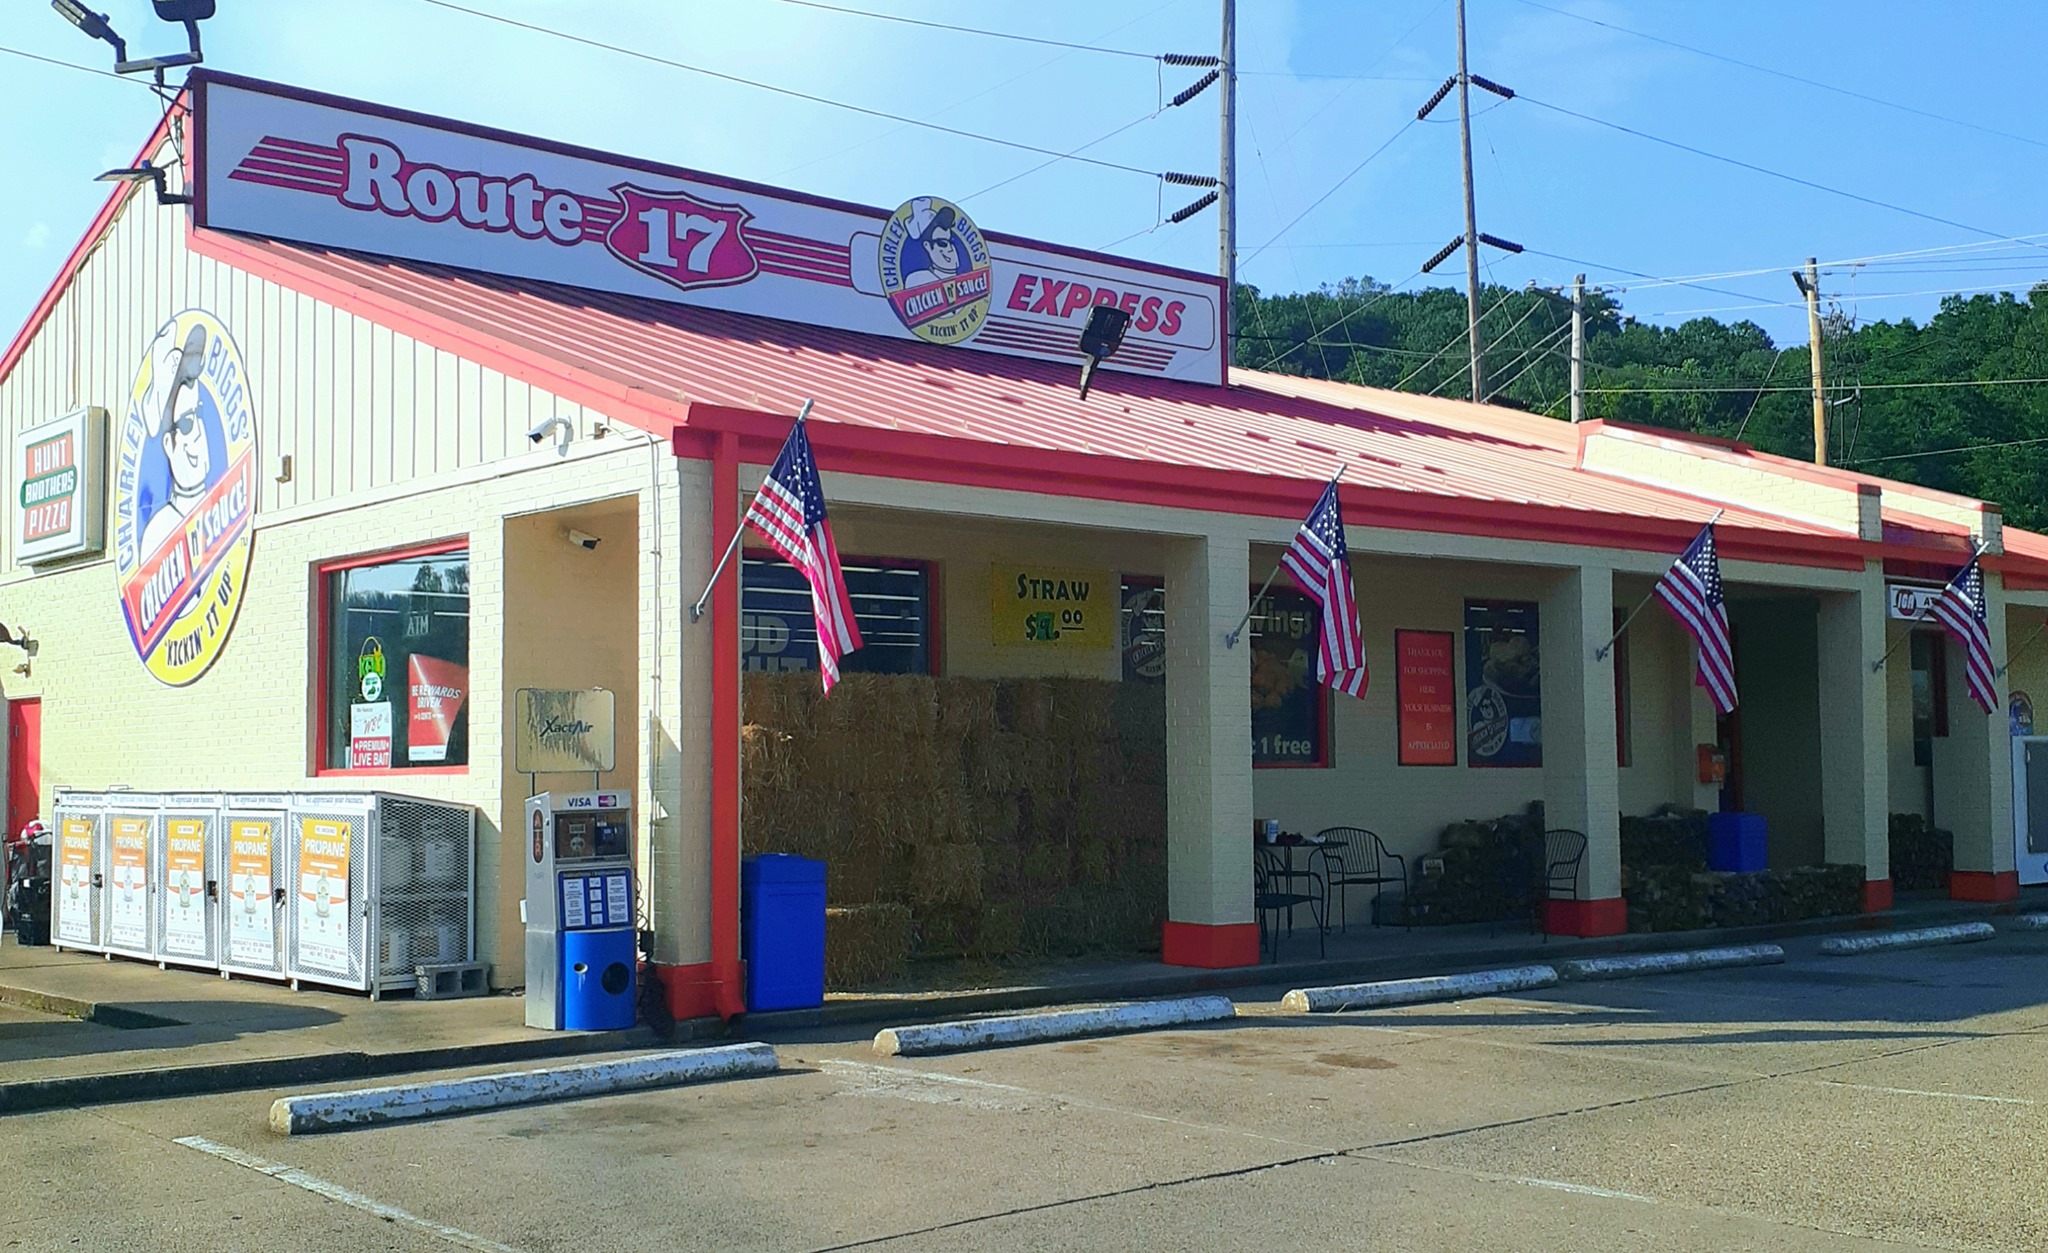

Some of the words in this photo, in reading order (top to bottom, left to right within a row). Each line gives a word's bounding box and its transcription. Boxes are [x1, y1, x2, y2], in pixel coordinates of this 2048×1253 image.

[339, 134, 585, 244] Route
[637, 205, 728, 274] 17
[882, 217, 905, 288] CHARLEY
[905, 287, 944, 317] CHICKEN
[1006, 273, 1186, 336] EXPRESS
[959, 317, 969, 331] IT
[34, 439, 67, 474] HUNT
[25, 470, 74, 504] BROTHERS
[118, 400, 144, 575] CHARLEY
[29, 500, 68, 536] PIZZA
[140, 540, 187, 633] CHICKEN
[1017, 573, 1090, 601] STRAW
[205, 601, 219, 638] IT
[406, 613, 429, 637] ATM
[411, 684, 418, 697] BE
[419, 684, 461, 699] REWARDS
[1405, 703, 1423, 712] YOUR
[1260, 736, 1268, 755] 1
[1273, 733, 1312, 755] free
[1407, 741, 1450, 750] APPRECIATED
[353, 752, 372, 767] LIVE
[373, 752, 389, 767] BAIT
[567, 797, 592, 807] VISA
[64, 836, 90, 849] PROPANE
[115, 836, 144, 849] PROPANE
[170, 838, 201, 852] PROPANE
[233, 840, 268, 856] PROPANE
[304, 838, 346, 858] PROPANE
